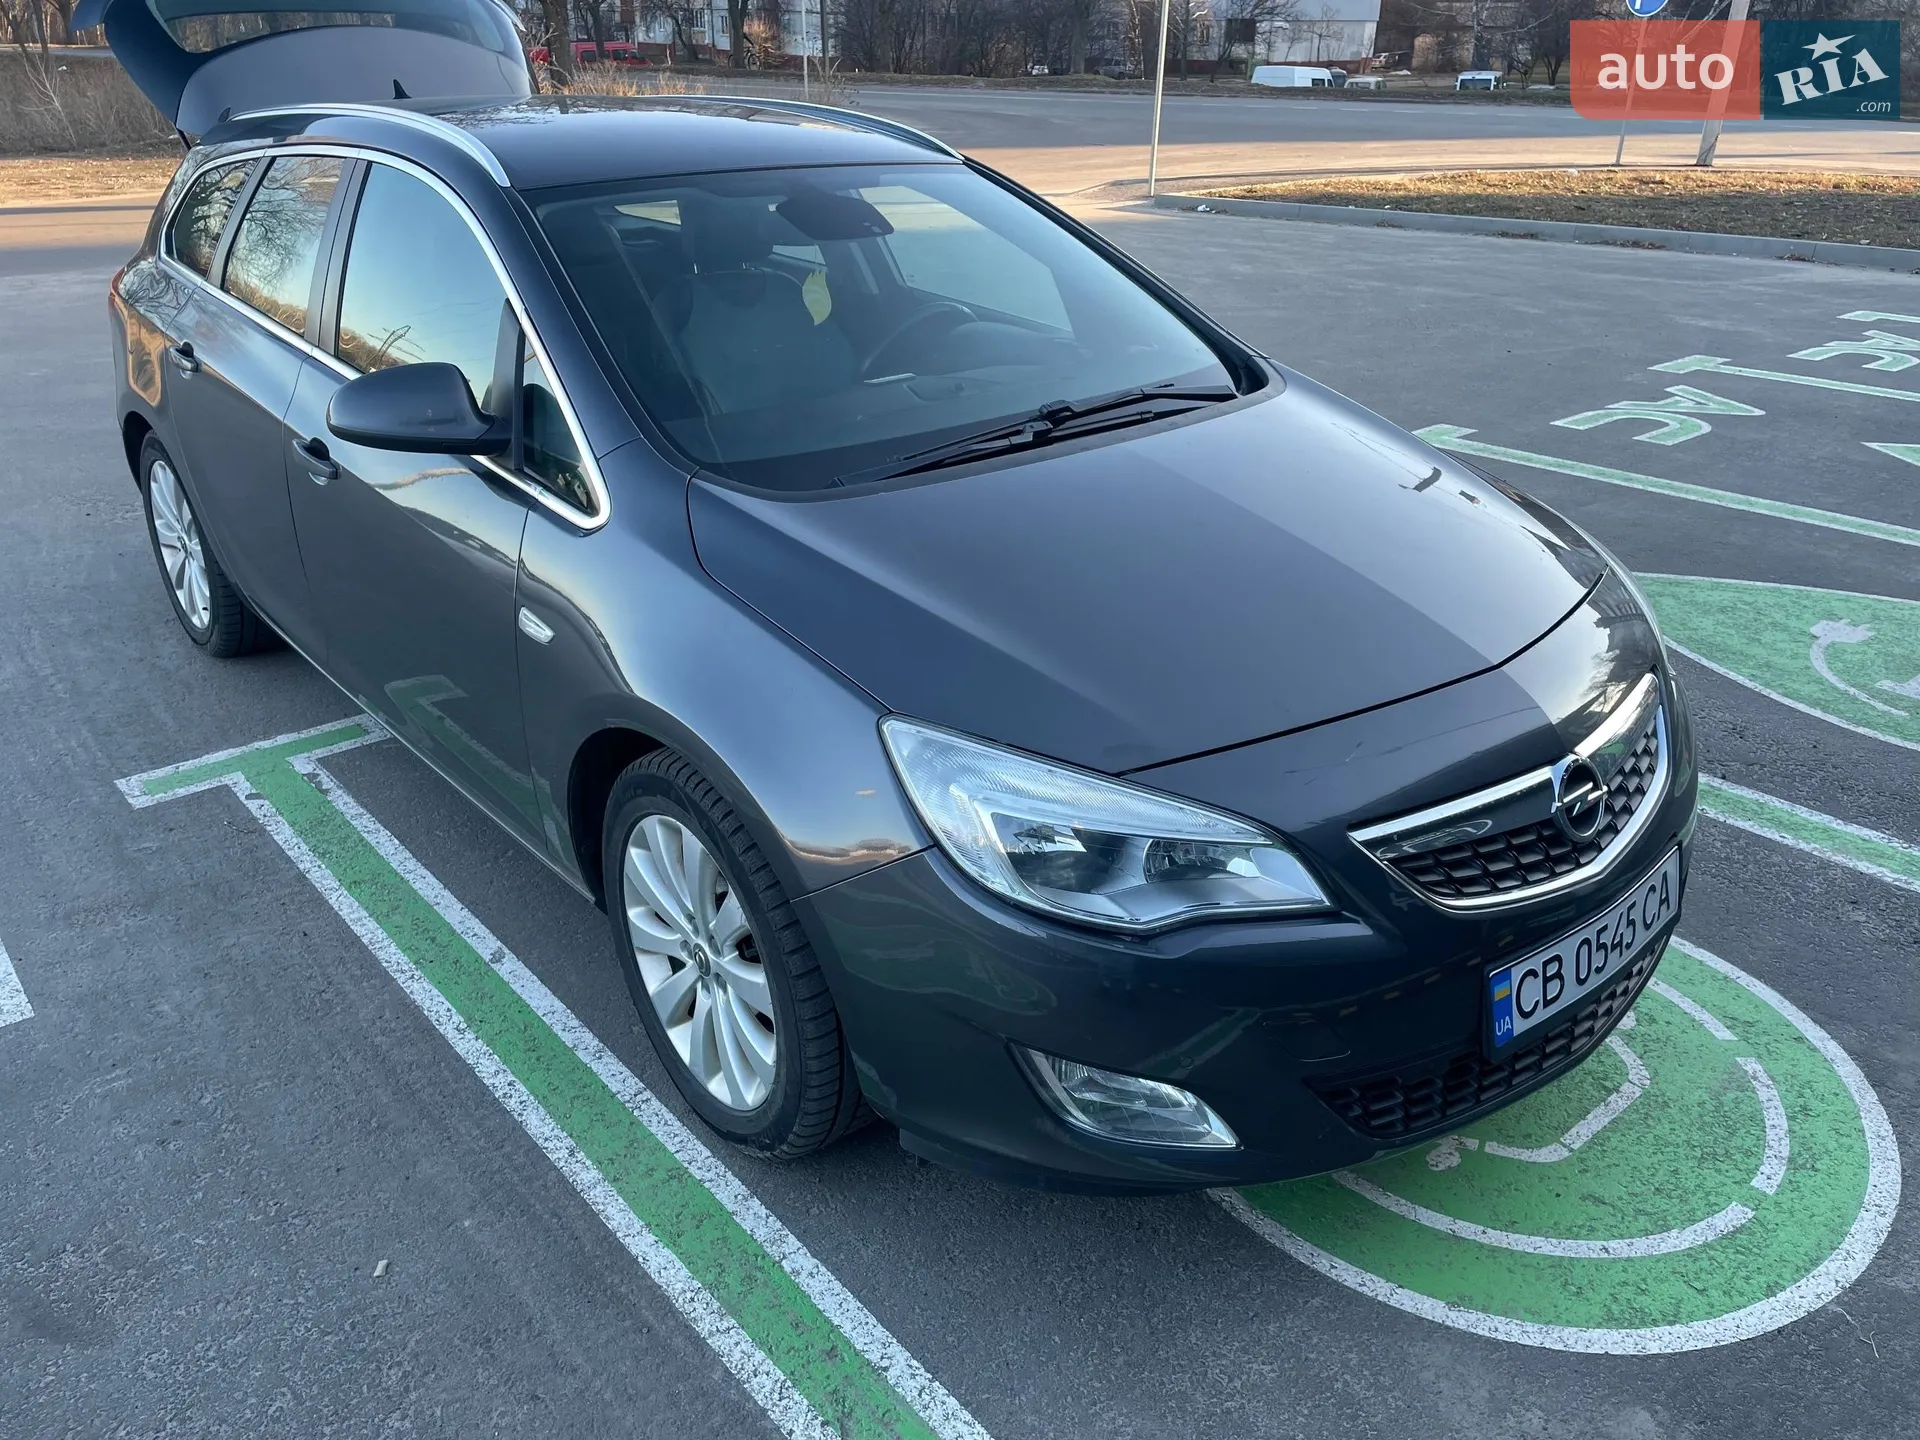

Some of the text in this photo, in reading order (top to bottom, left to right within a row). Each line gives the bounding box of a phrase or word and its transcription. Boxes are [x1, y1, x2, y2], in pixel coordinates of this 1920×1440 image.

[1515, 869, 1671, 1019] CB 0545 CA
[1495, 1015, 1512, 1036] UA
